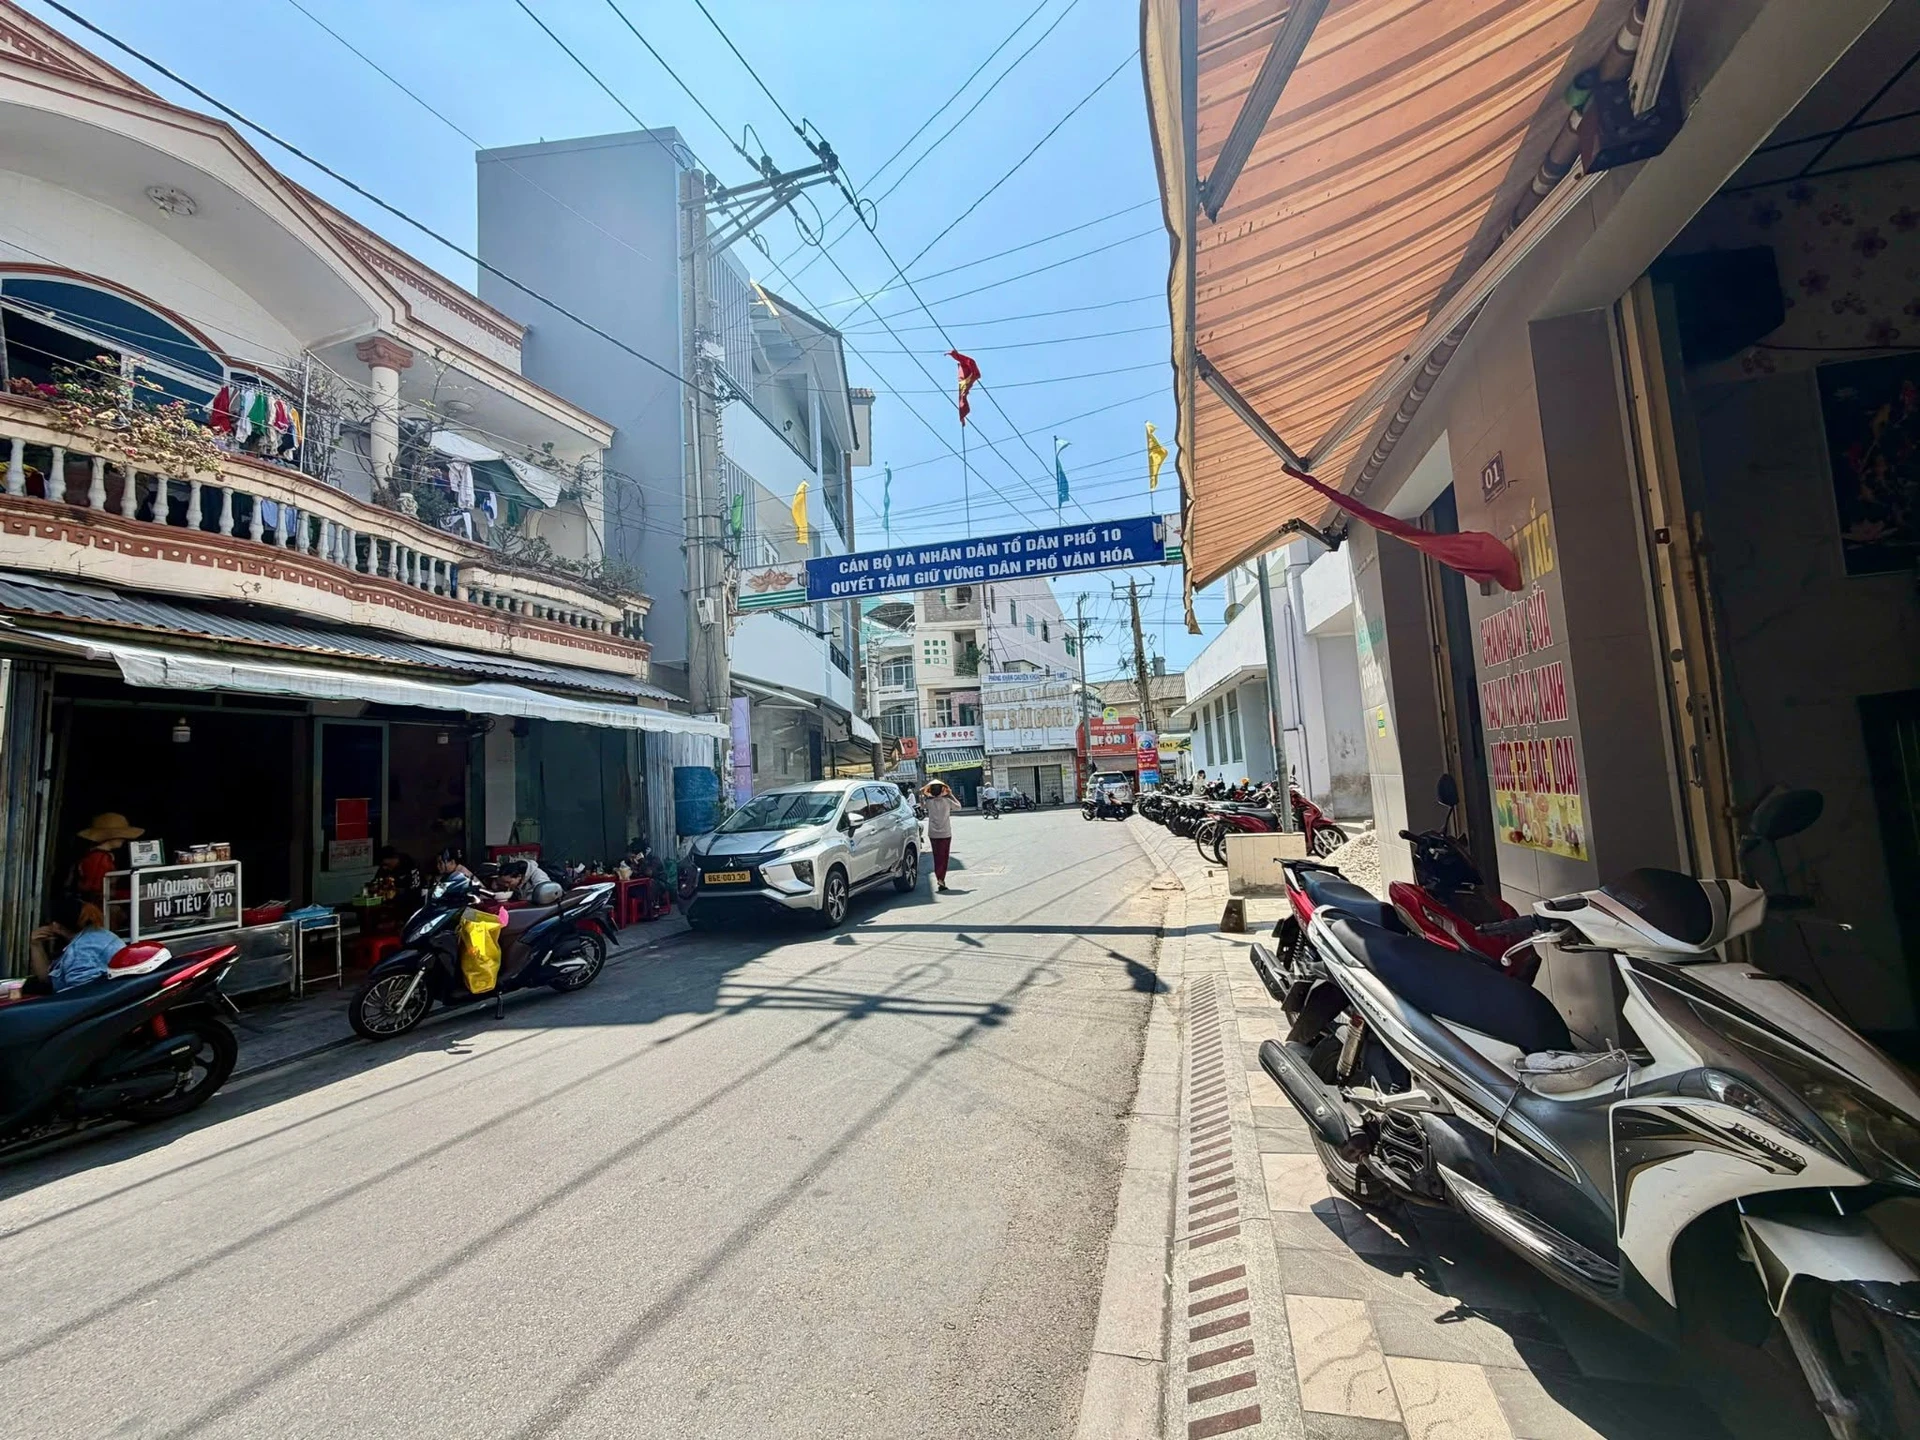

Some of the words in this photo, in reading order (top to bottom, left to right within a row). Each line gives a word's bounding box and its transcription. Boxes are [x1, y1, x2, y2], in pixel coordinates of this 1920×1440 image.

[1484, 462, 1501, 489] 01
[831, 575, 875, 594] QUYẾT
[878, 573, 910, 588] TÂM
[914, 568, 941, 584] GIỮ
[943, 565, 984, 581] VỮNG
[988, 561, 1021, 577] DÂN
[1026, 552, 1058, 571] PHỐ
[1062, 550, 1096, 567] VĂN
[1100, 546, 1135, 563] HÓA
[839, 557, 869, 574] CÁN
[872, 553, 893, 571] BỘ
[896, 551, 916, 567] VÀ
[920, 547, 961, 564] NHÂN
[966, 542, 998, 559] DÂN
[1002, 536, 1021, 555] TỔ
[1026, 534, 1059, 551] DÂN
[1063, 527, 1097, 547] PHỐ
[1102, 528, 1122, 542] 10
[1480, 609, 1511, 669] CHANH
[1527, 580, 1554, 653] SỮA
[1008, 704, 1033, 730] SÀI
[1034, 705, 1063, 729] GÒN
[1063, 706, 1074, 727] 2
[1481, 679, 1503, 730] RAU
[1498, 663, 1518, 728] MÁ
[1533, 661, 1569, 723] XANH
[951, 730, 975, 739] NGỌC
[1490, 731, 1517, 793] NƯỚC
[1513, 728, 1528, 793] ÉP
[1528, 726, 1552, 794] CÁC
[1548, 736, 1580, 810] LOẠI
[154, 895, 172, 918] HỦ
[174, 893, 202, 914] TIẾU
[210, 892, 233, 908] HEO
[1735, 1123, 1806, 1165] HONDA
